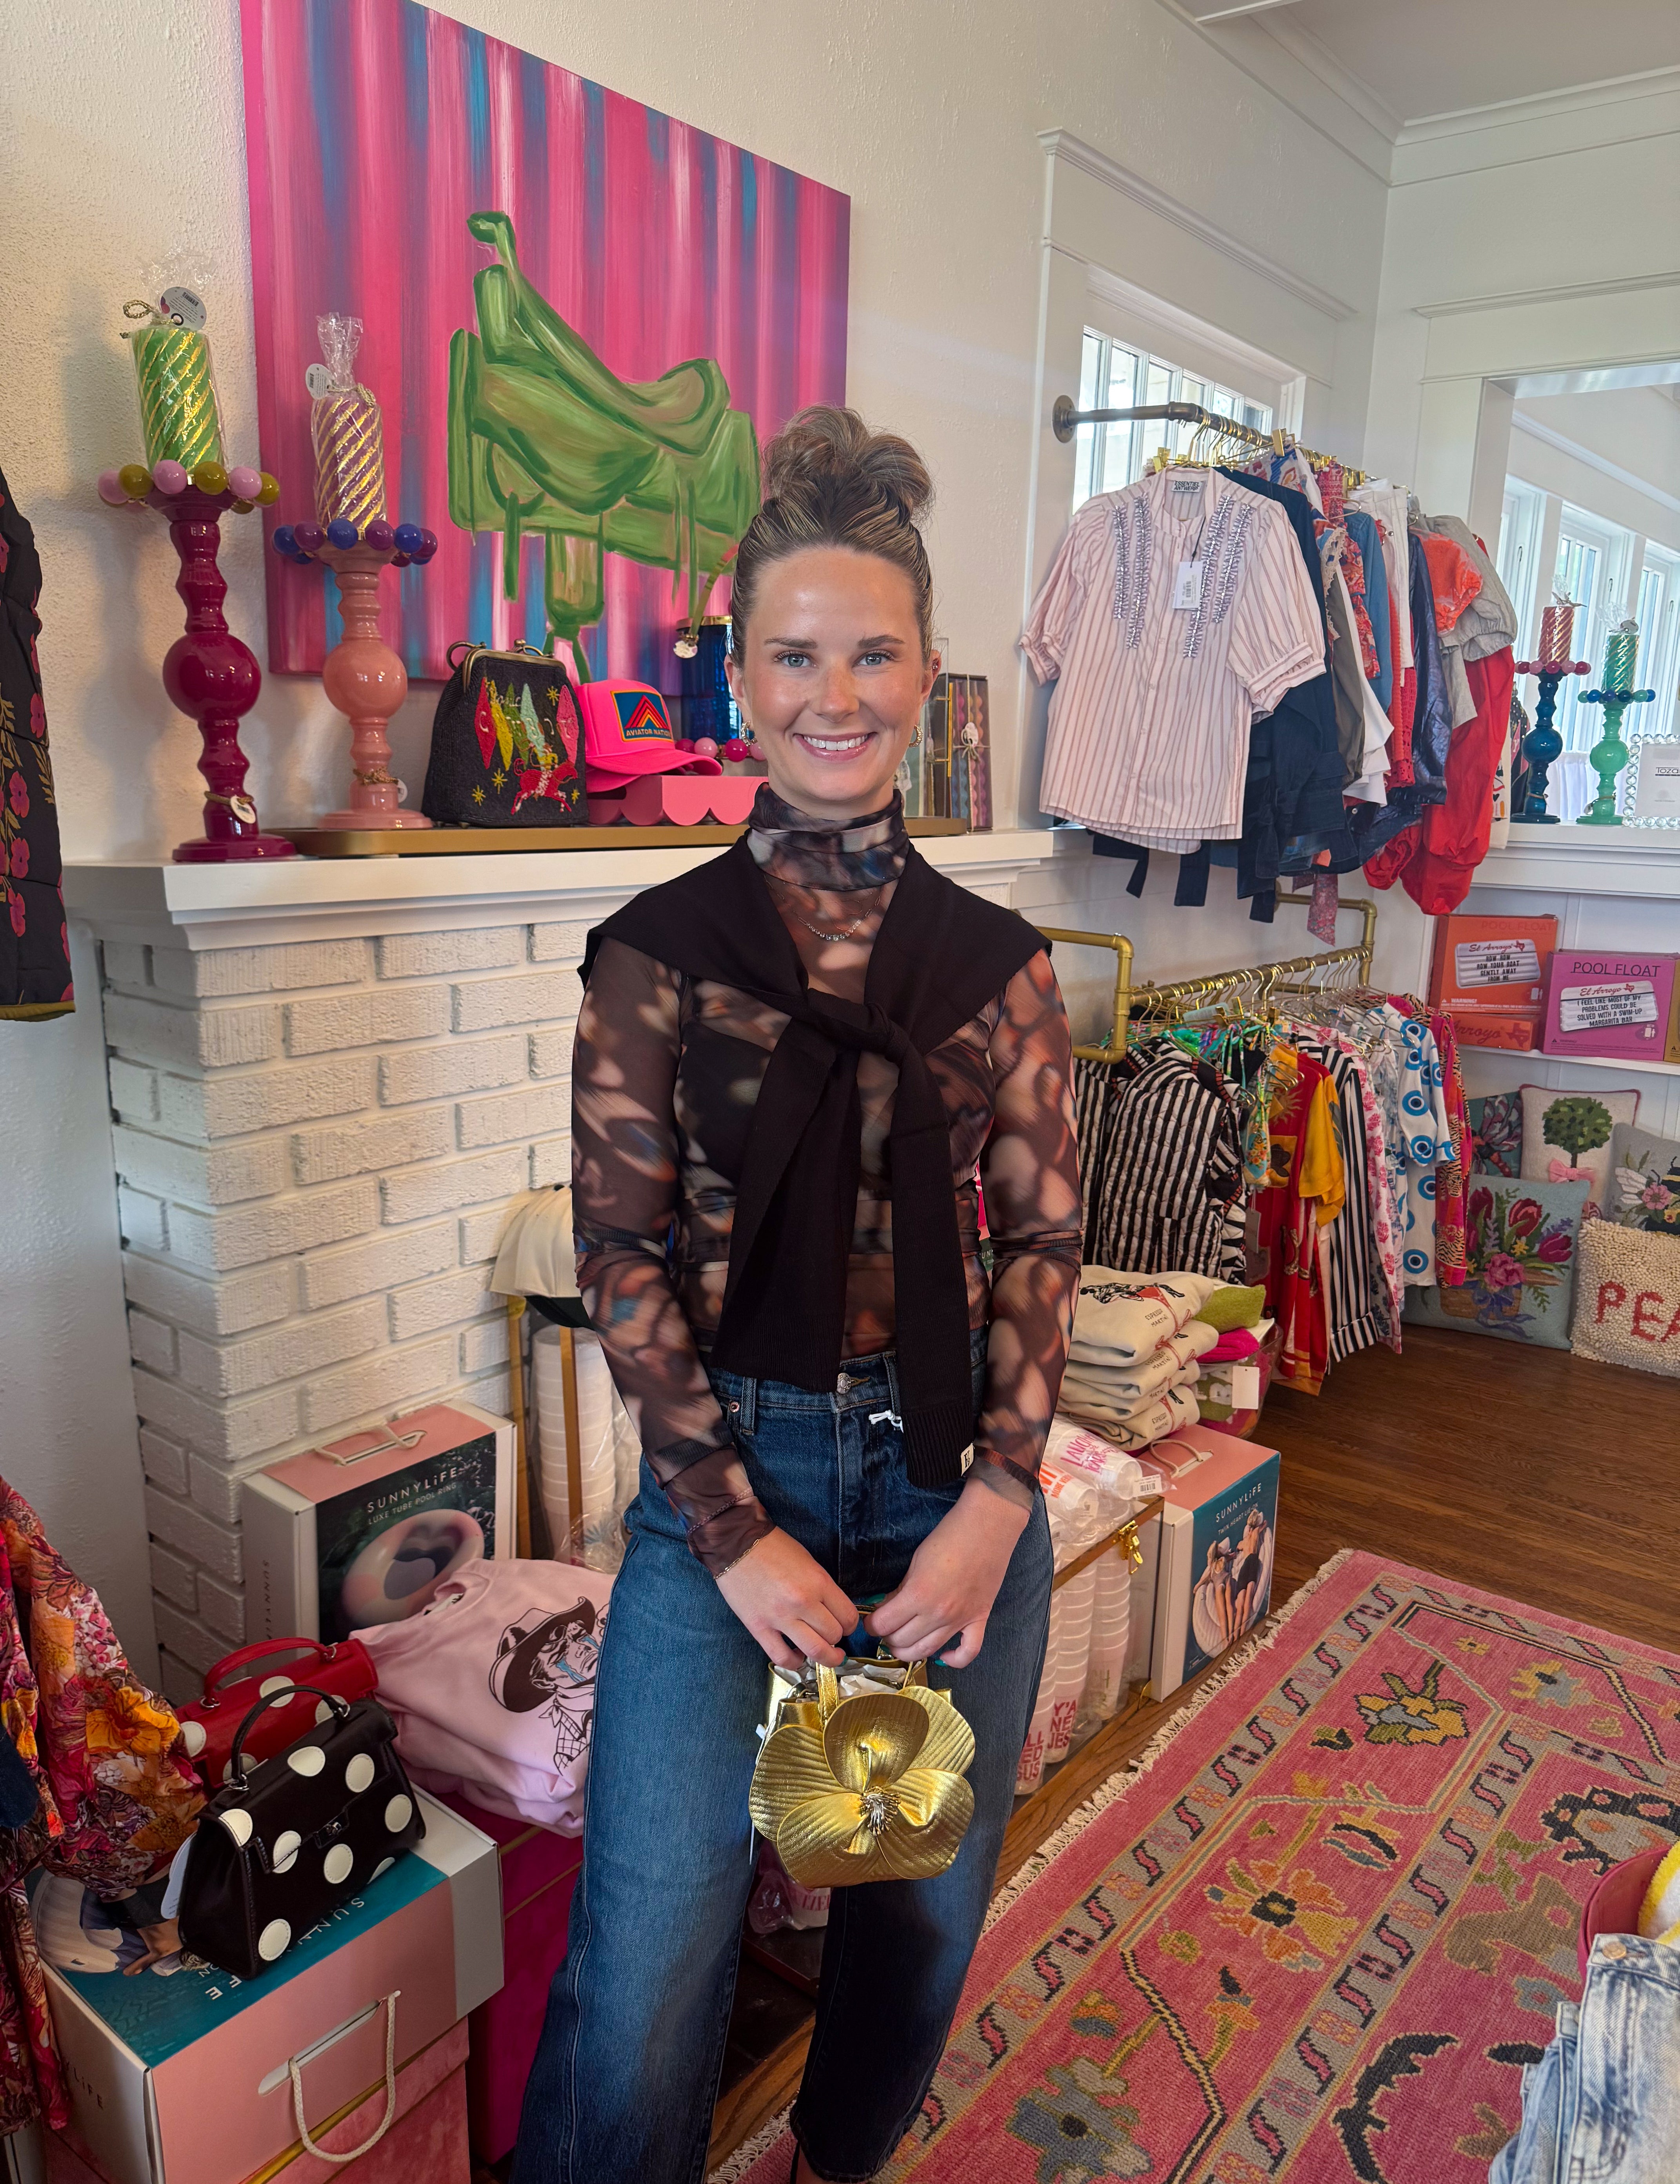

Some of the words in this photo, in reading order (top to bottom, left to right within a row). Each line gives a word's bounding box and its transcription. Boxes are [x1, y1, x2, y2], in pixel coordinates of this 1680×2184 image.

[1482, 944, 1512, 953] Arroyo
[1573, 962, 1611, 975] POOL
[1615, 964, 1661, 977] FLOAT
[1580, 987, 1591, 996] El
[1592, 986, 1622, 995] Arroyo
[1589, 1018, 1619, 1027] MARGARITA
[368, 1511, 389, 1524] LUXE
[392, 1501, 412, 1514] TUBE
[415, 1493, 435, 1505] POOL
[438, 1482, 456, 1495] RING
